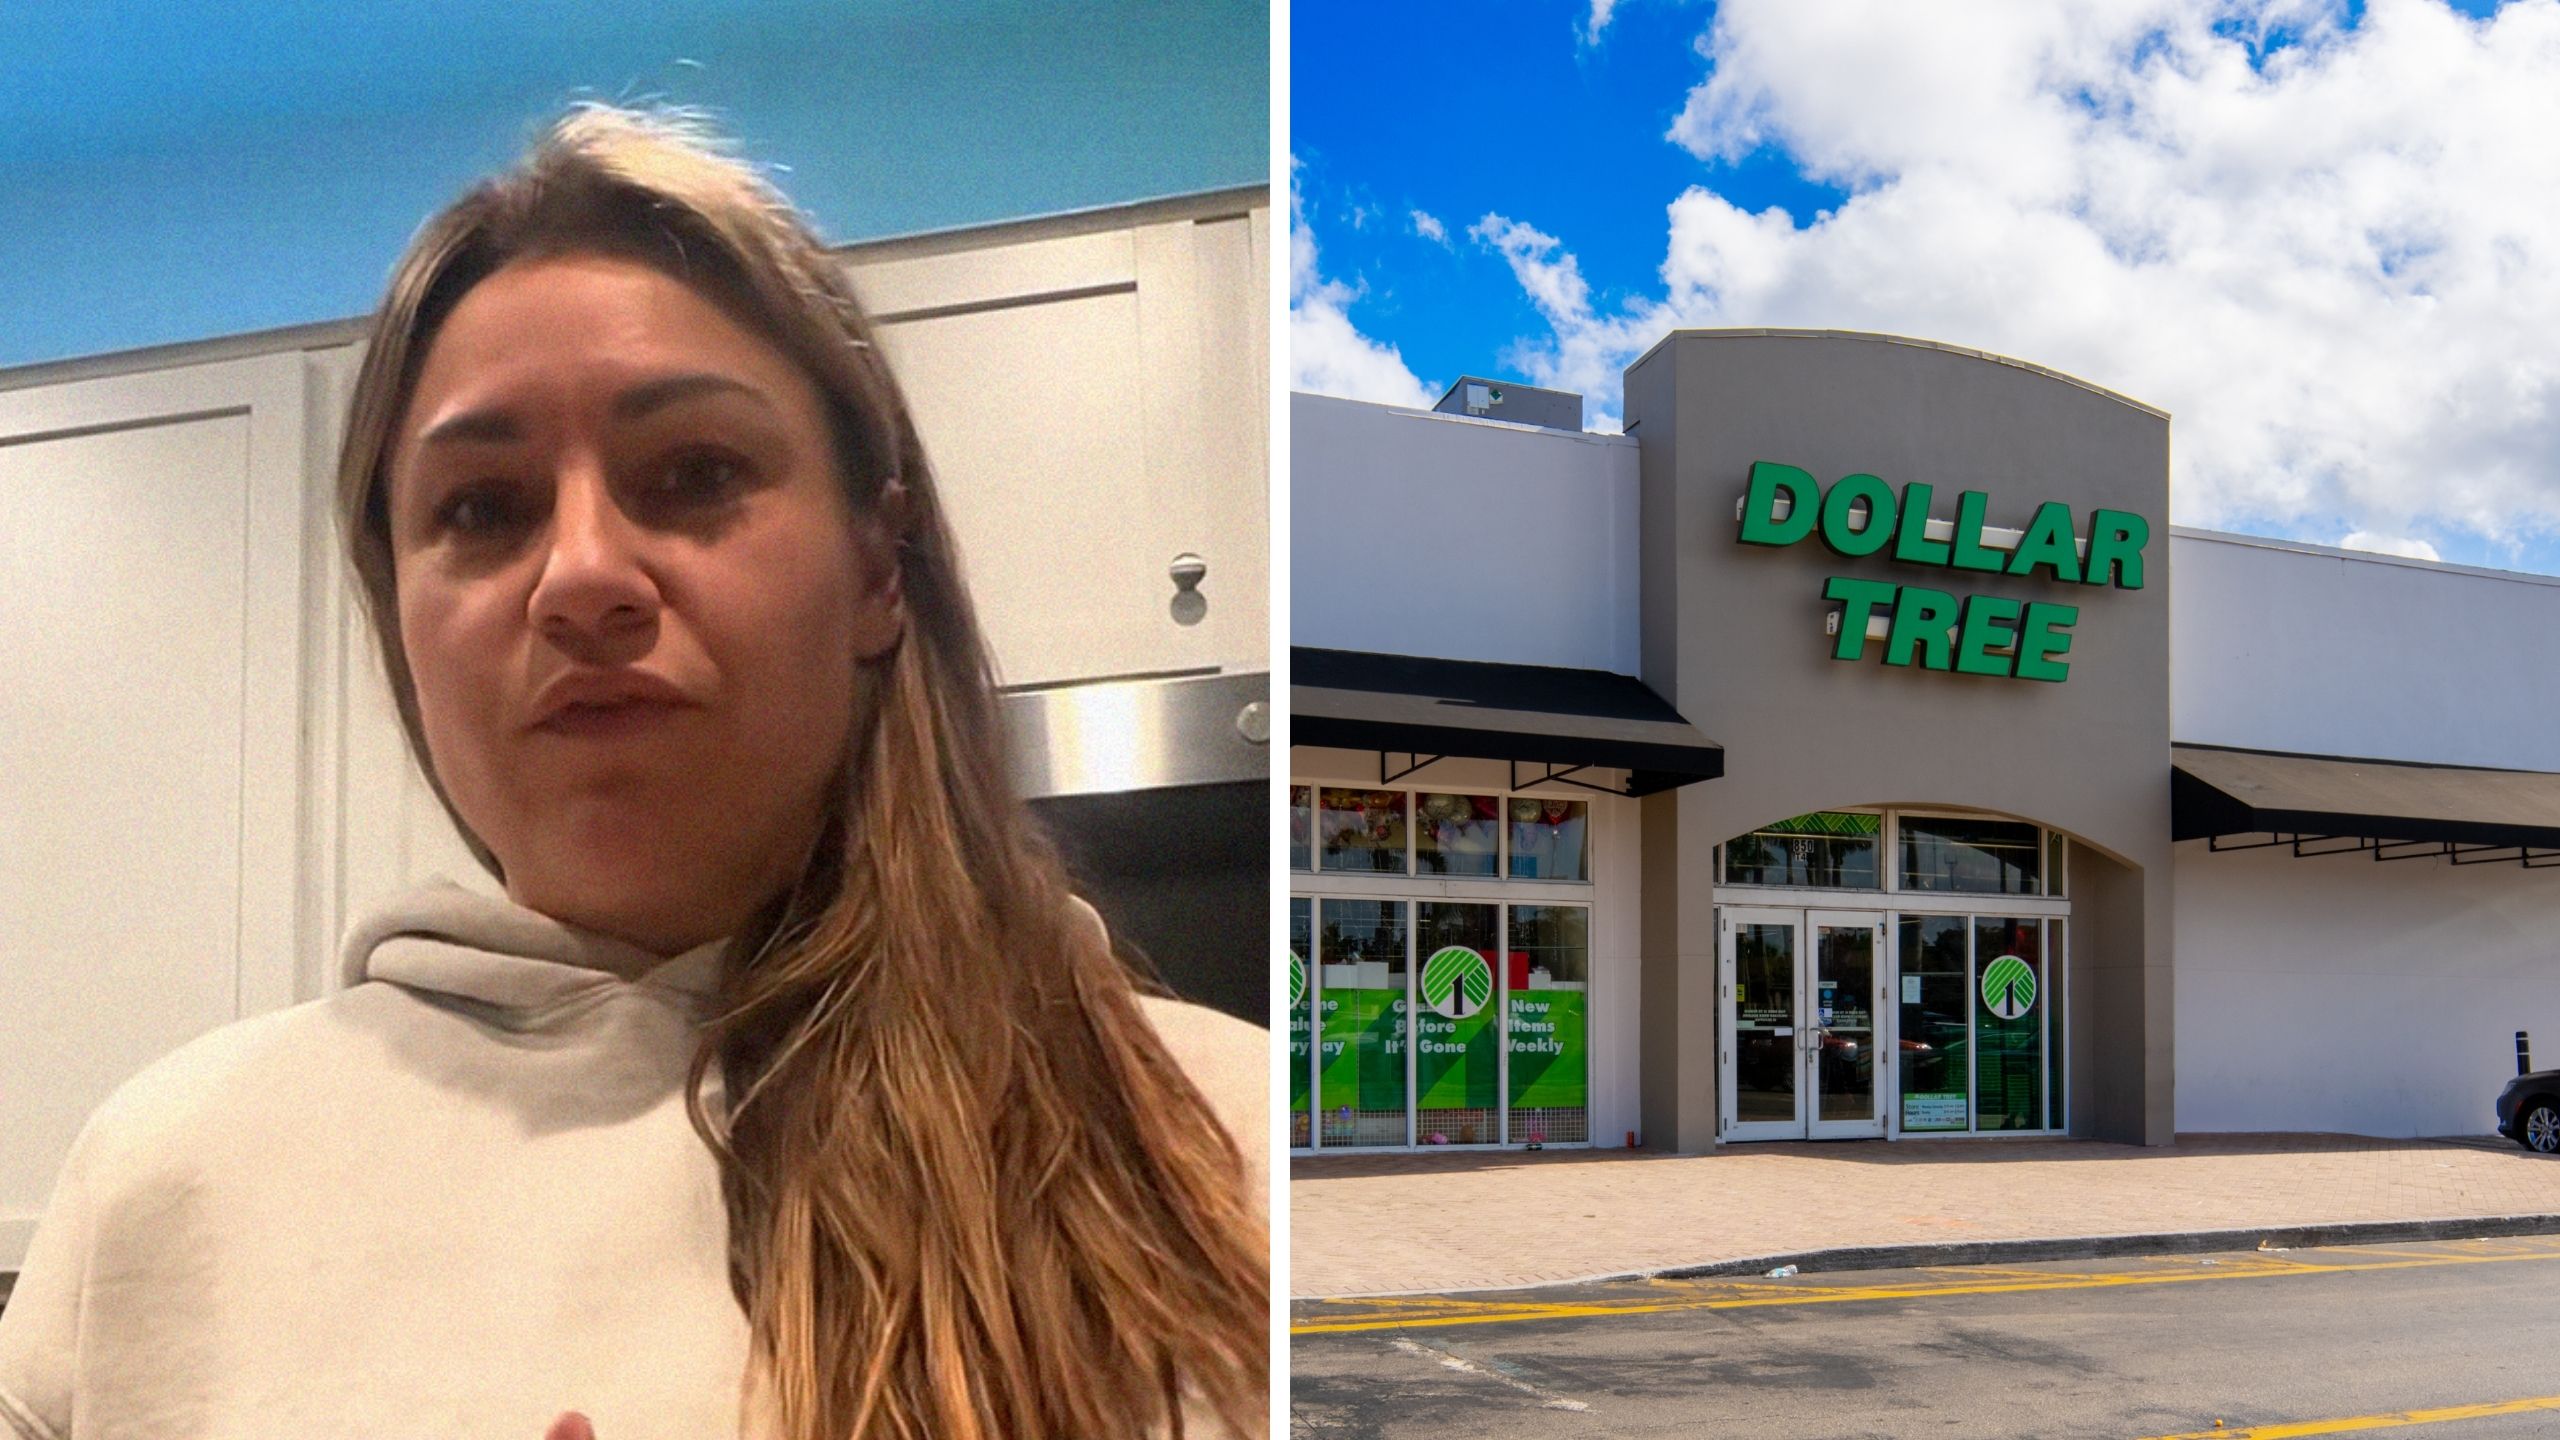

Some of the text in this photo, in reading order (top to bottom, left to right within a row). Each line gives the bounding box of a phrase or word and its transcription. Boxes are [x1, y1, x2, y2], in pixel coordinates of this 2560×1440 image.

[1737, 461, 2149, 589] DOLLAR
[1821, 576, 2079, 682] TREE
[1794, 839, 1813, 852] 850
[1511, 999, 1550, 1013] New
[1395, 1018, 1456, 1033] Bfore
[1508, 1019, 1555, 1032] Items
[1290, 1040, 1345, 1055] ryay
[1385, 1039, 1466, 1053] It' Gone
